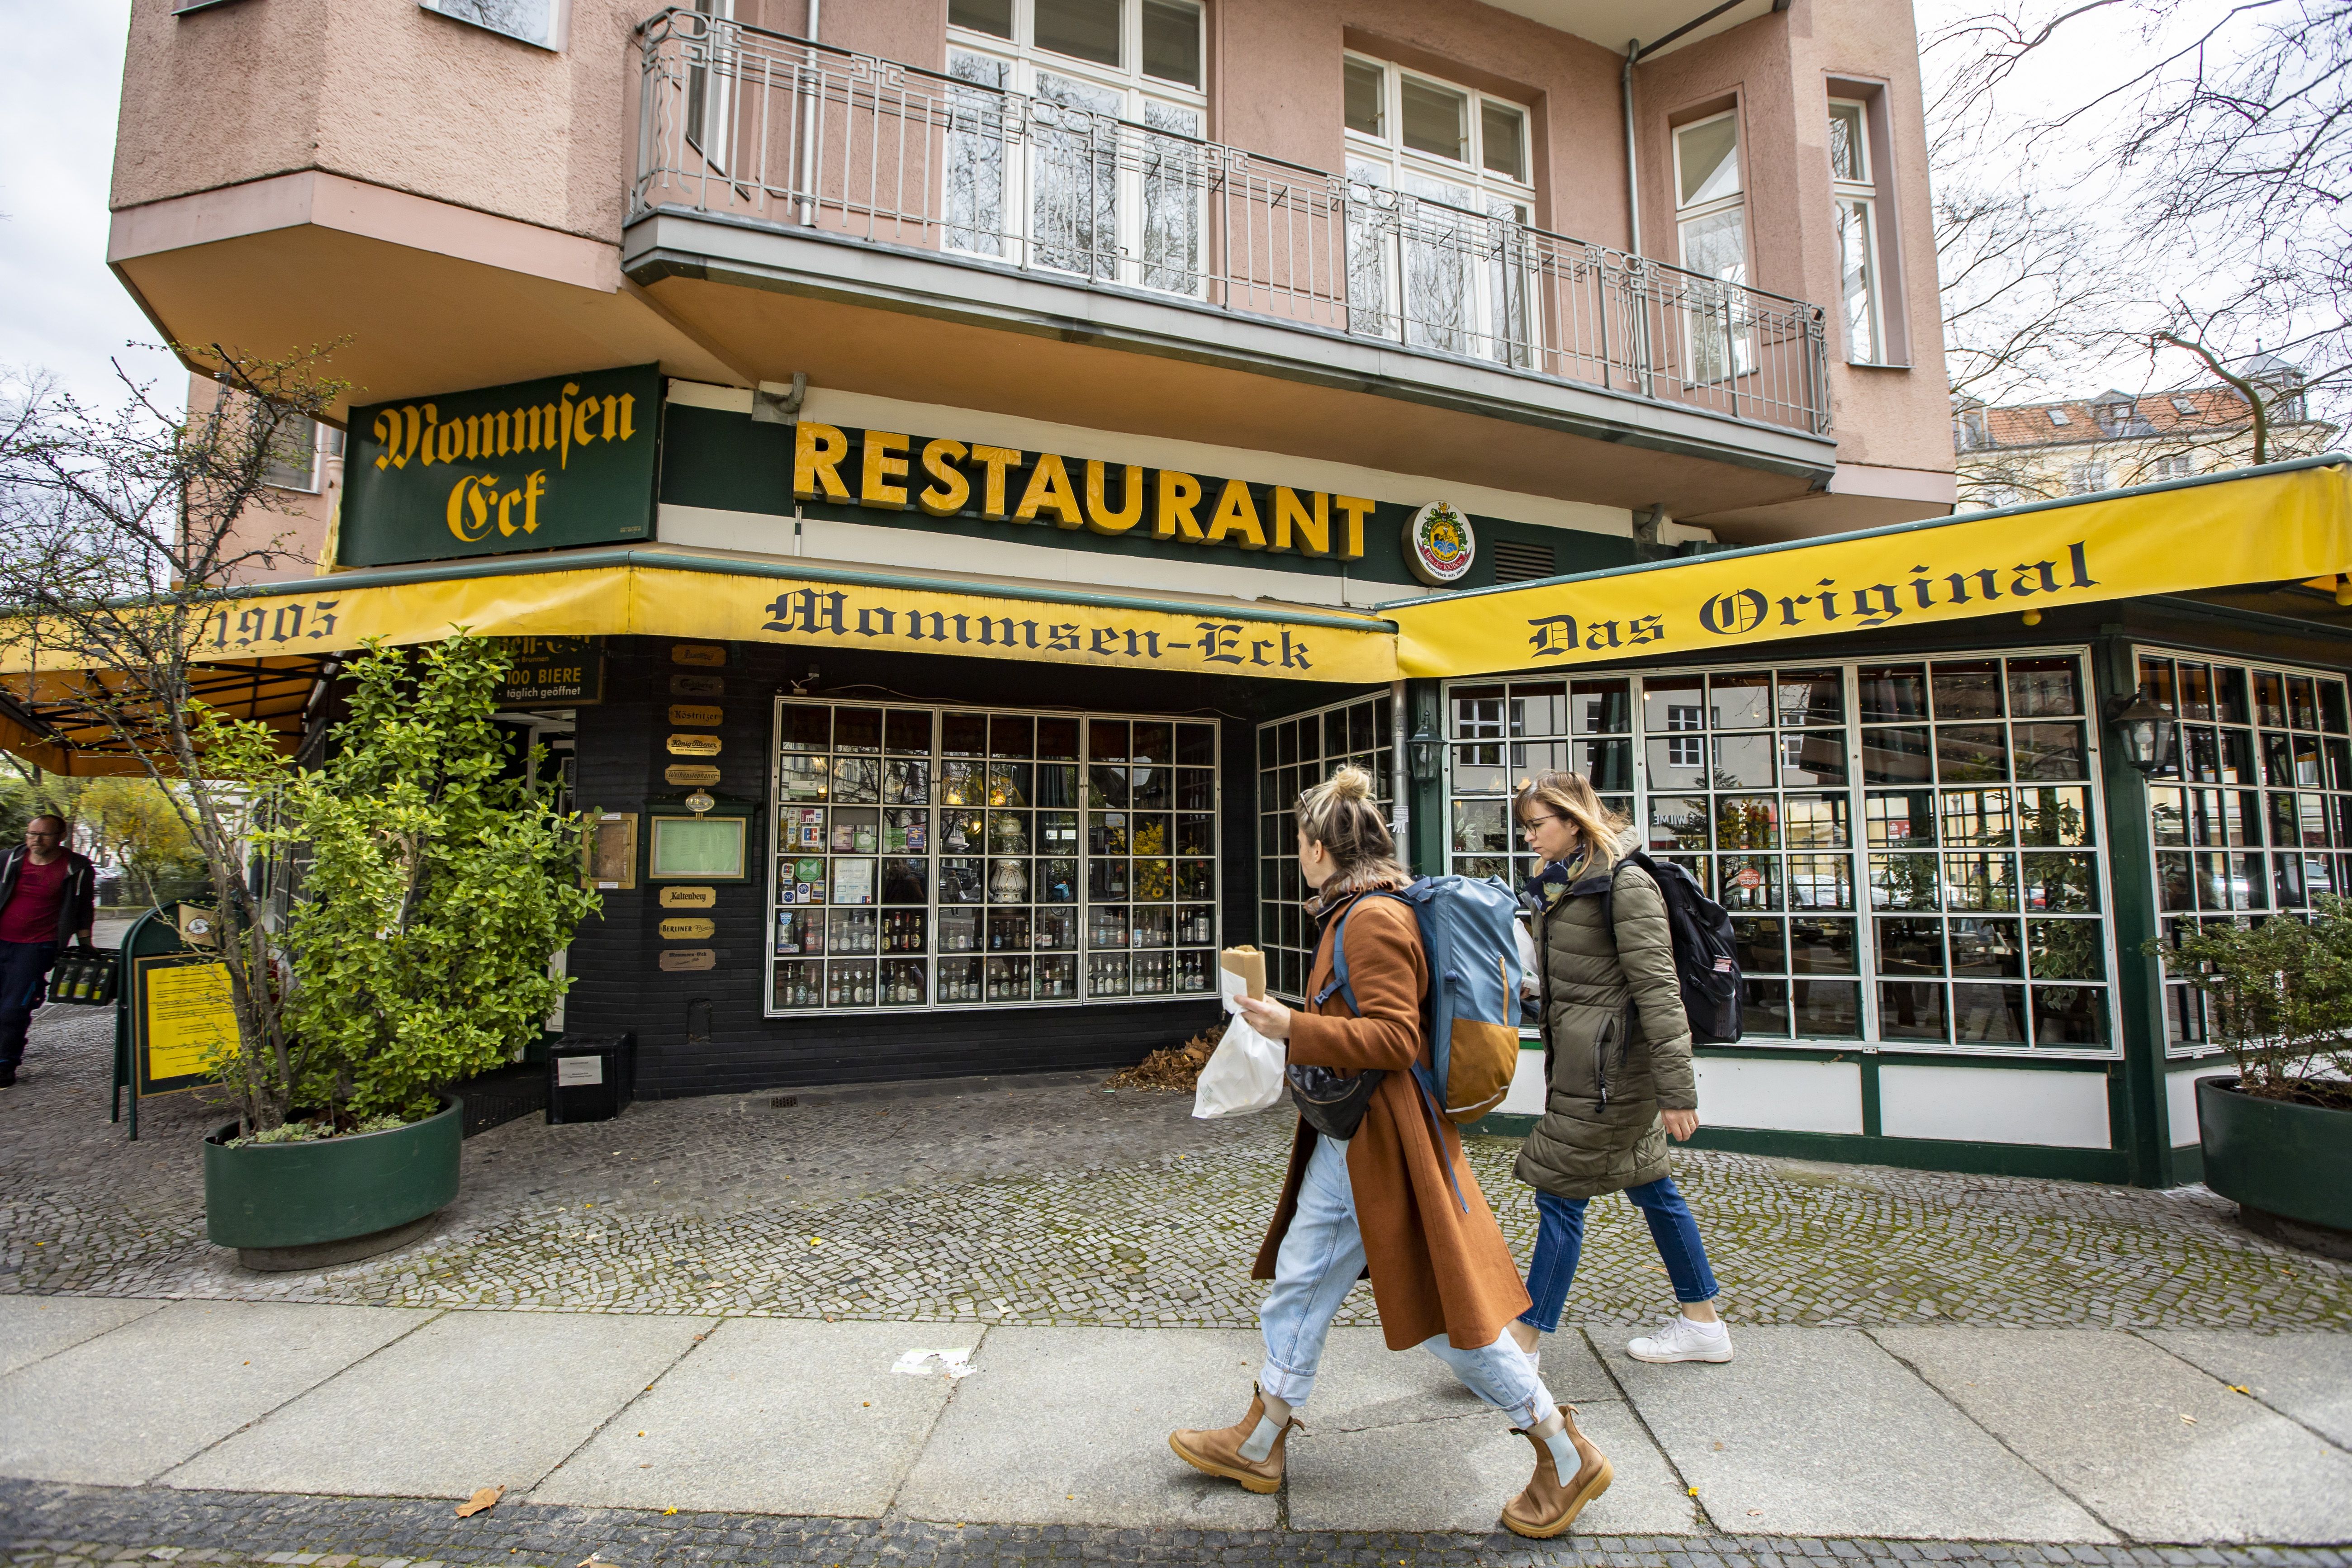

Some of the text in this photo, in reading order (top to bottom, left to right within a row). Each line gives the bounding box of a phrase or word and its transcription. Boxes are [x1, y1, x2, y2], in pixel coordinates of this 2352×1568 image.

[374, 382, 636, 471] Mommsen
[446, 469, 546, 542] Eck
[793, 421, 1375, 561] RESTAURANT
[1425, 552, 1434, 562] Haus
[1453, 559, 1464, 568] Biere
[1425, 562, 1447, 578] Gastlichkeit
[1456, 567, 1465, 575] 1905
[1528, 540, 2101, 658] Das Original
[212, 599, 339, 649] 1905
[762, 587, 1314, 670] Mommsen-Eck
[506, 670, 530, 685] 100
[538, 667, 582, 684] BIERE
[507, 686, 581, 700] täglich geöffnet
[674, 711, 717, 722] Köstritzer
[669, 892, 706, 902] Kaltenberg
